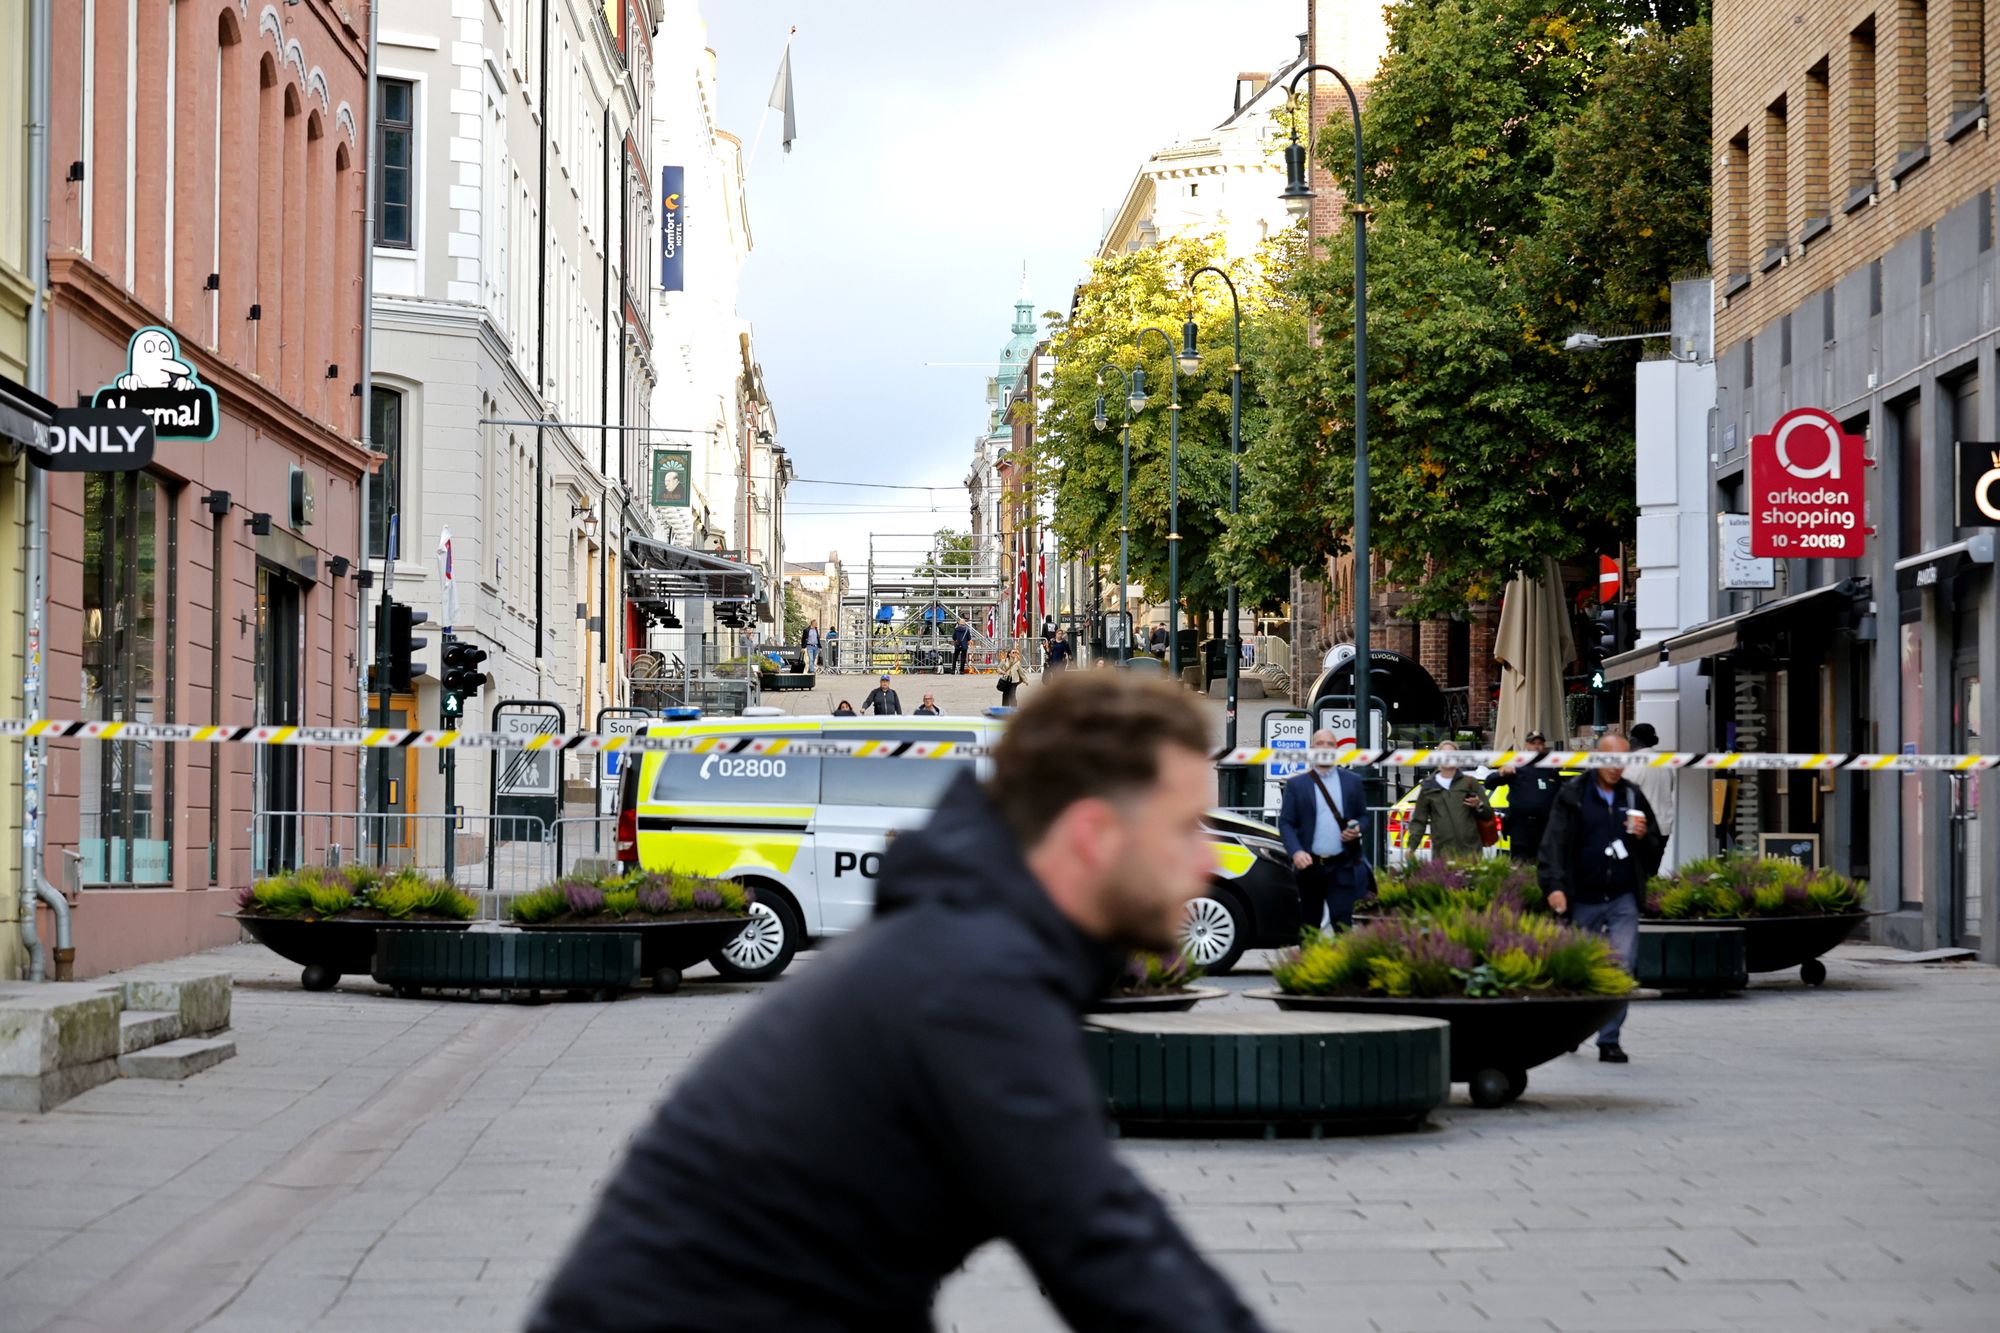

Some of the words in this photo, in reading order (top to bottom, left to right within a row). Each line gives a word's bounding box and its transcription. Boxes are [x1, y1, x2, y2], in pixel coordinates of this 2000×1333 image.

[664, 212, 675, 258] Comfort
[49, 425, 147, 454] ONLY
[1767, 487, 1849, 505] arkaden
[1761, 507, 1855, 529] shopping
[1771, 535, 1788, 547] 10
[1800, 534, 1846, 548] 20(18)
[1371, 652, 1399, 663] ELVOGNA
[610, 722, 633, 734] Son
[1274, 722, 1304, 735] Sone
[125, 727, 191, 738] POLITI
[297, 728, 362, 741] POLITI
[629, 738, 694, 750] POLITI
[1587, 753, 1650, 766] POLITI
[719, 758, 786, 778] 02800
[1735, 673, 1767, 858] Kafferenne
[834, 851, 882, 879] PO
